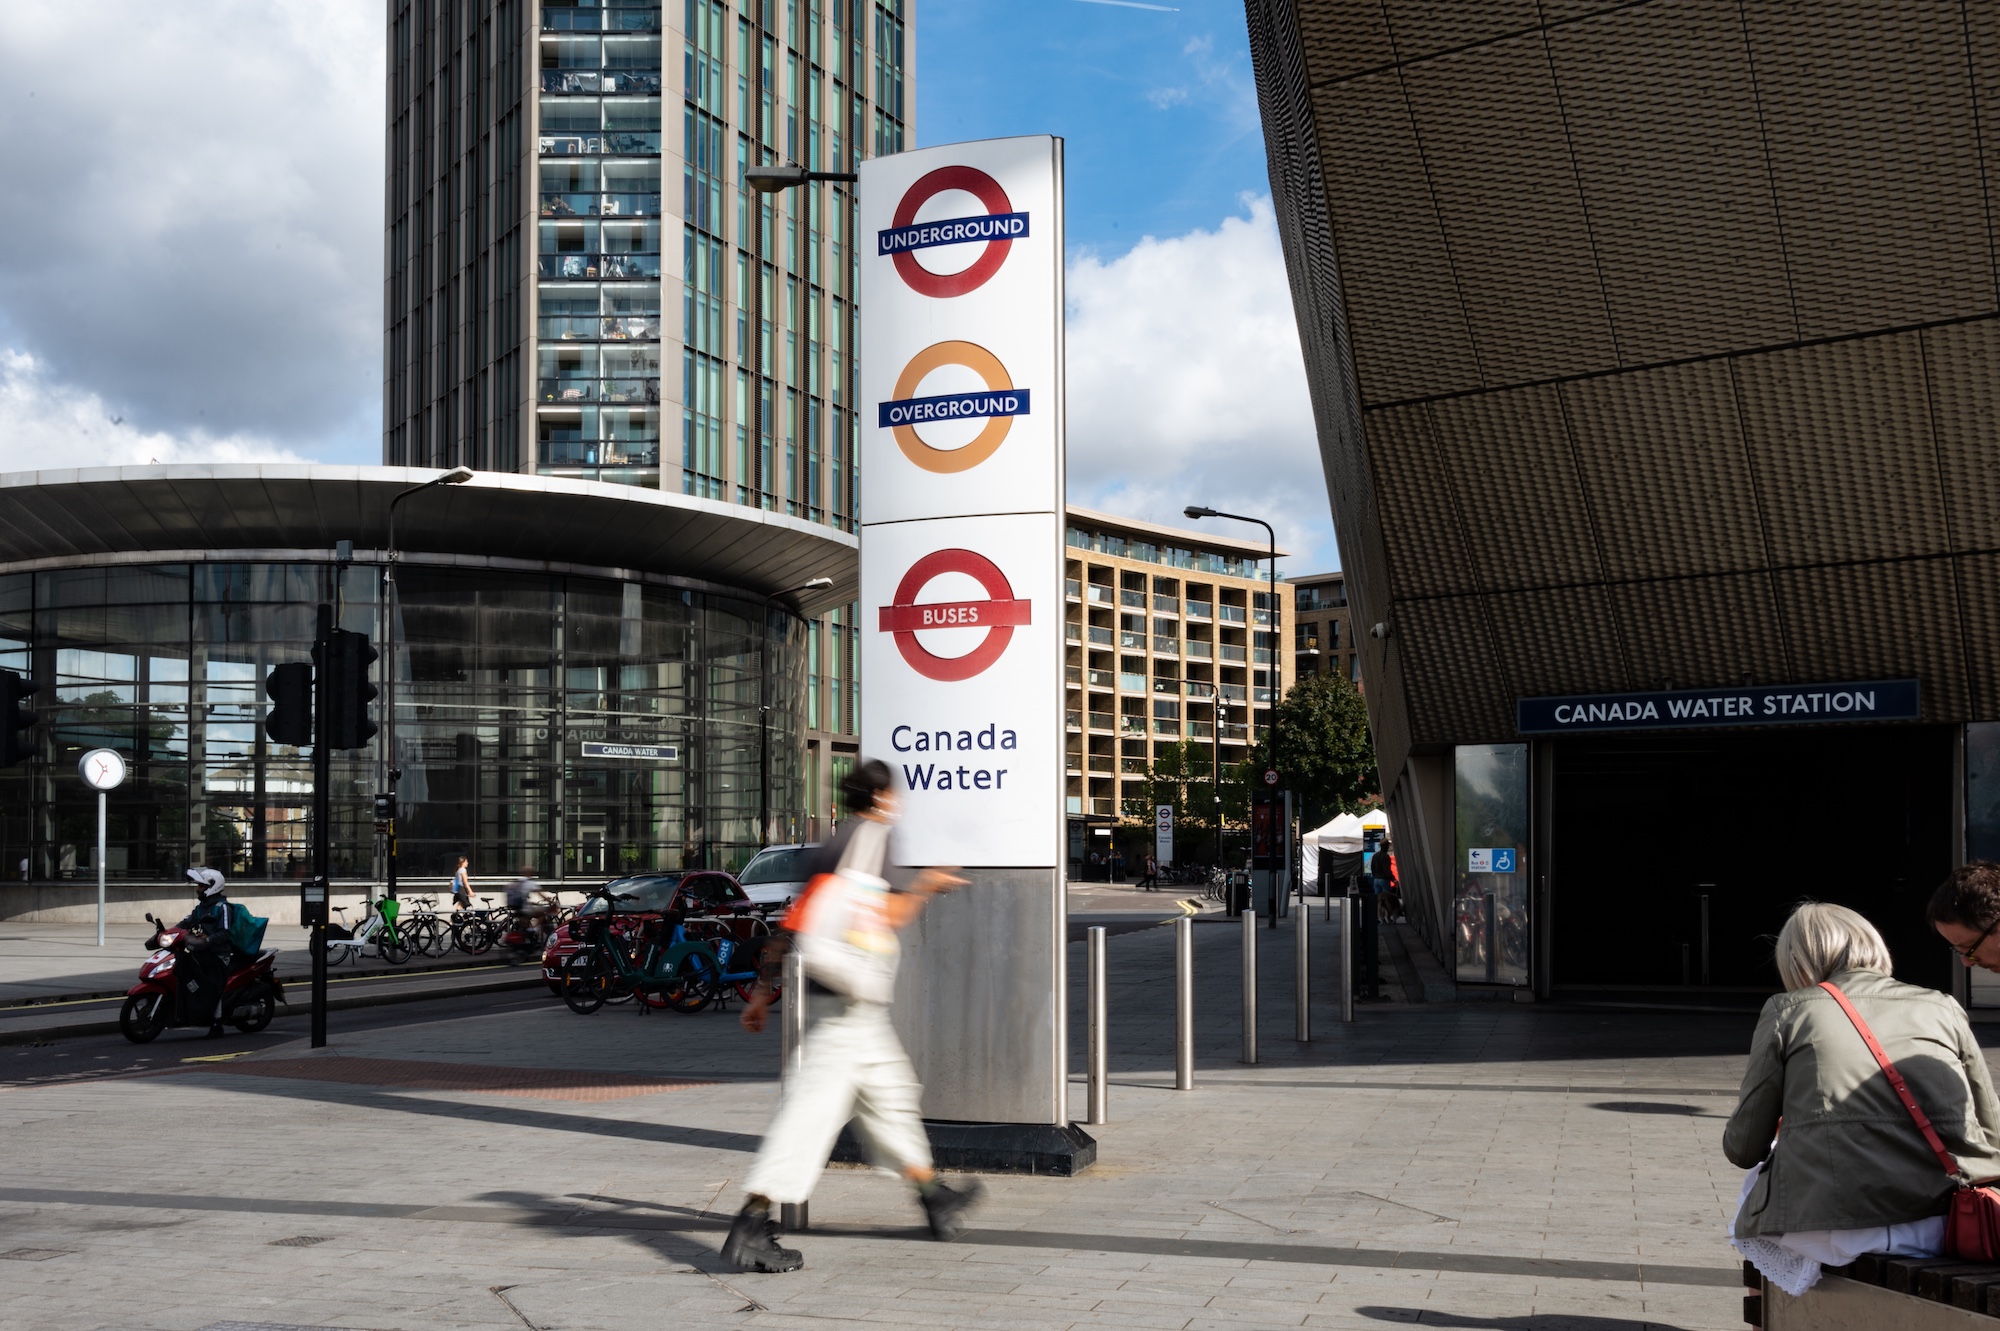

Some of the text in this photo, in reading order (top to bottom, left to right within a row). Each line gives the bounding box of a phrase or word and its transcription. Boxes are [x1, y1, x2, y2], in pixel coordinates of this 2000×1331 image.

[882, 218, 1024, 251] UNDERGROUND
[890, 396, 1019, 423] OVERGROUND
[923, 607, 978, 625] BUSES
[1555, 691, 1875, 723] CANADA WATER STATION
[891, 723, 1018, 752] Canada
[602, 746, 658, 757] CANADA WATER
[903, 763, 1008, 791] Water
[718, 942, 730, 965] dott
